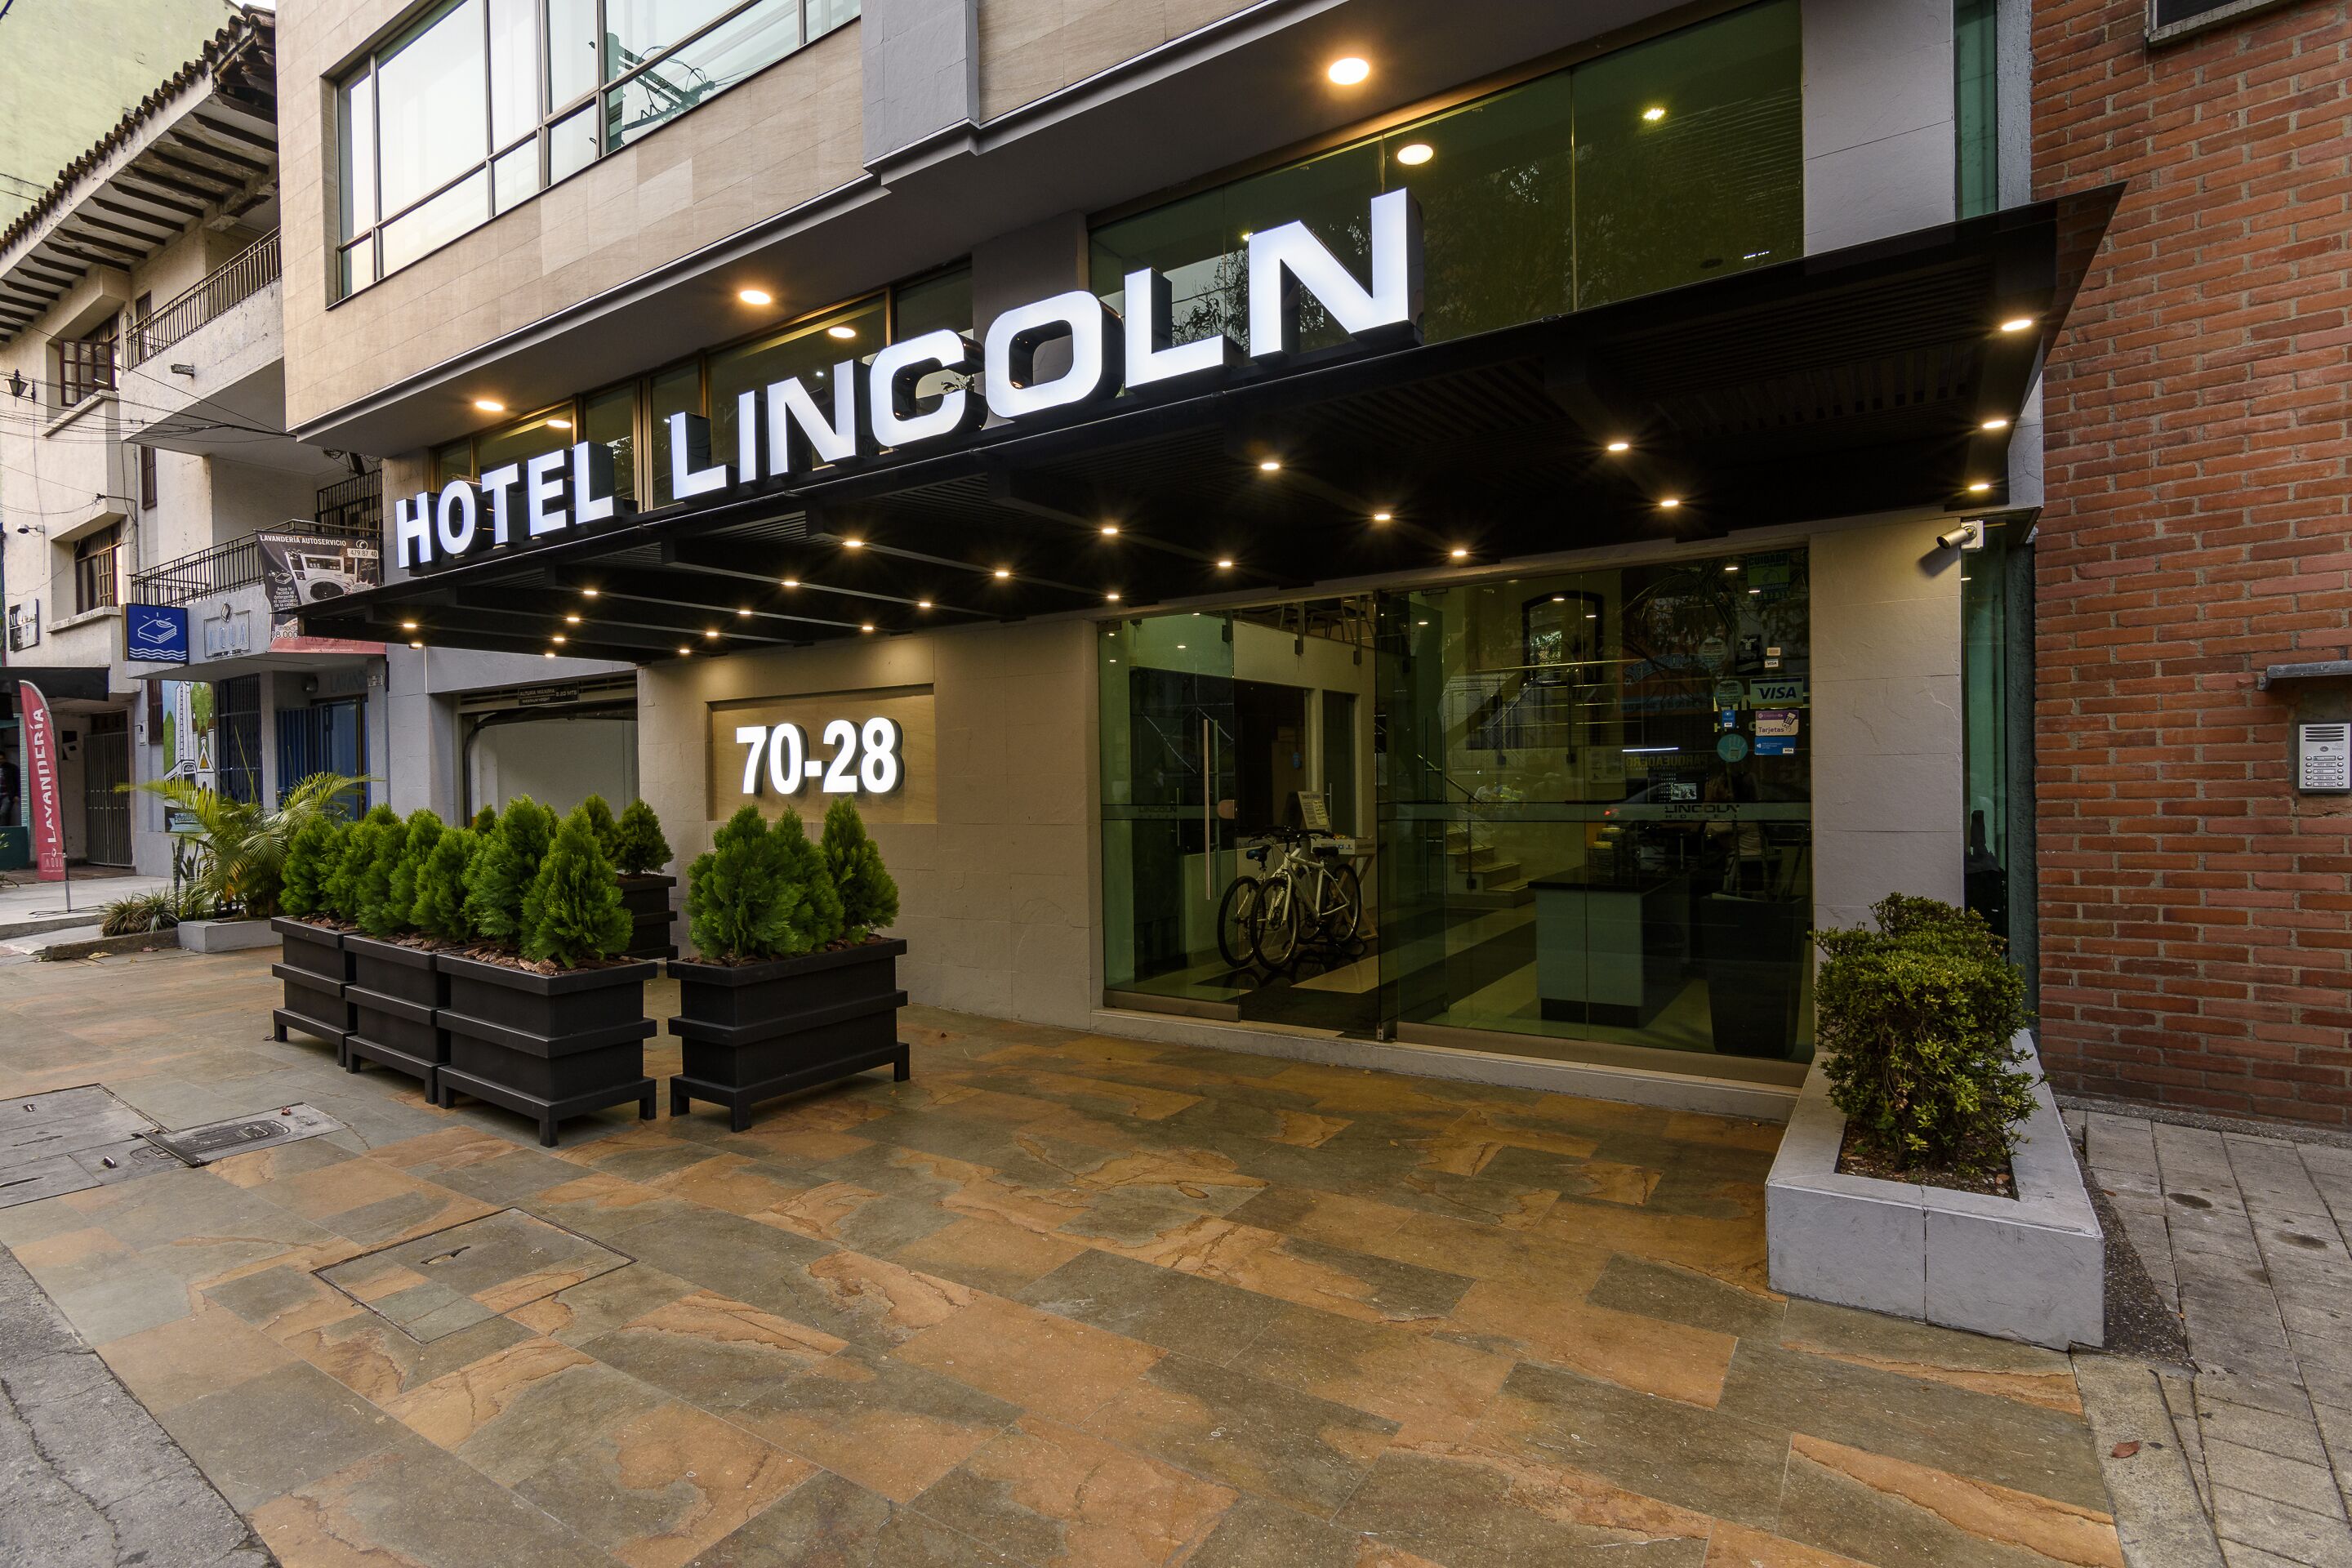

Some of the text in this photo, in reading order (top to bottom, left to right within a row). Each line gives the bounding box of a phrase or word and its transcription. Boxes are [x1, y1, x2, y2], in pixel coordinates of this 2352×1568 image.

[395, 187, 1410, 569] HOTEL LINCOLN
[260, 534, 346, 547] LAVANDERÍA AUTOSERVICIO
[1748, 553, 1788, 566] CUIDADO
[208, 622, 247, 651] AQUA
[1757, 686, 1797, 700] VISA
[736, 716, 899, 795] 70-28
[29, 708, 57, 844] LAVANDERÍA
[1664, 804, 1740, 813] LINCOLN
